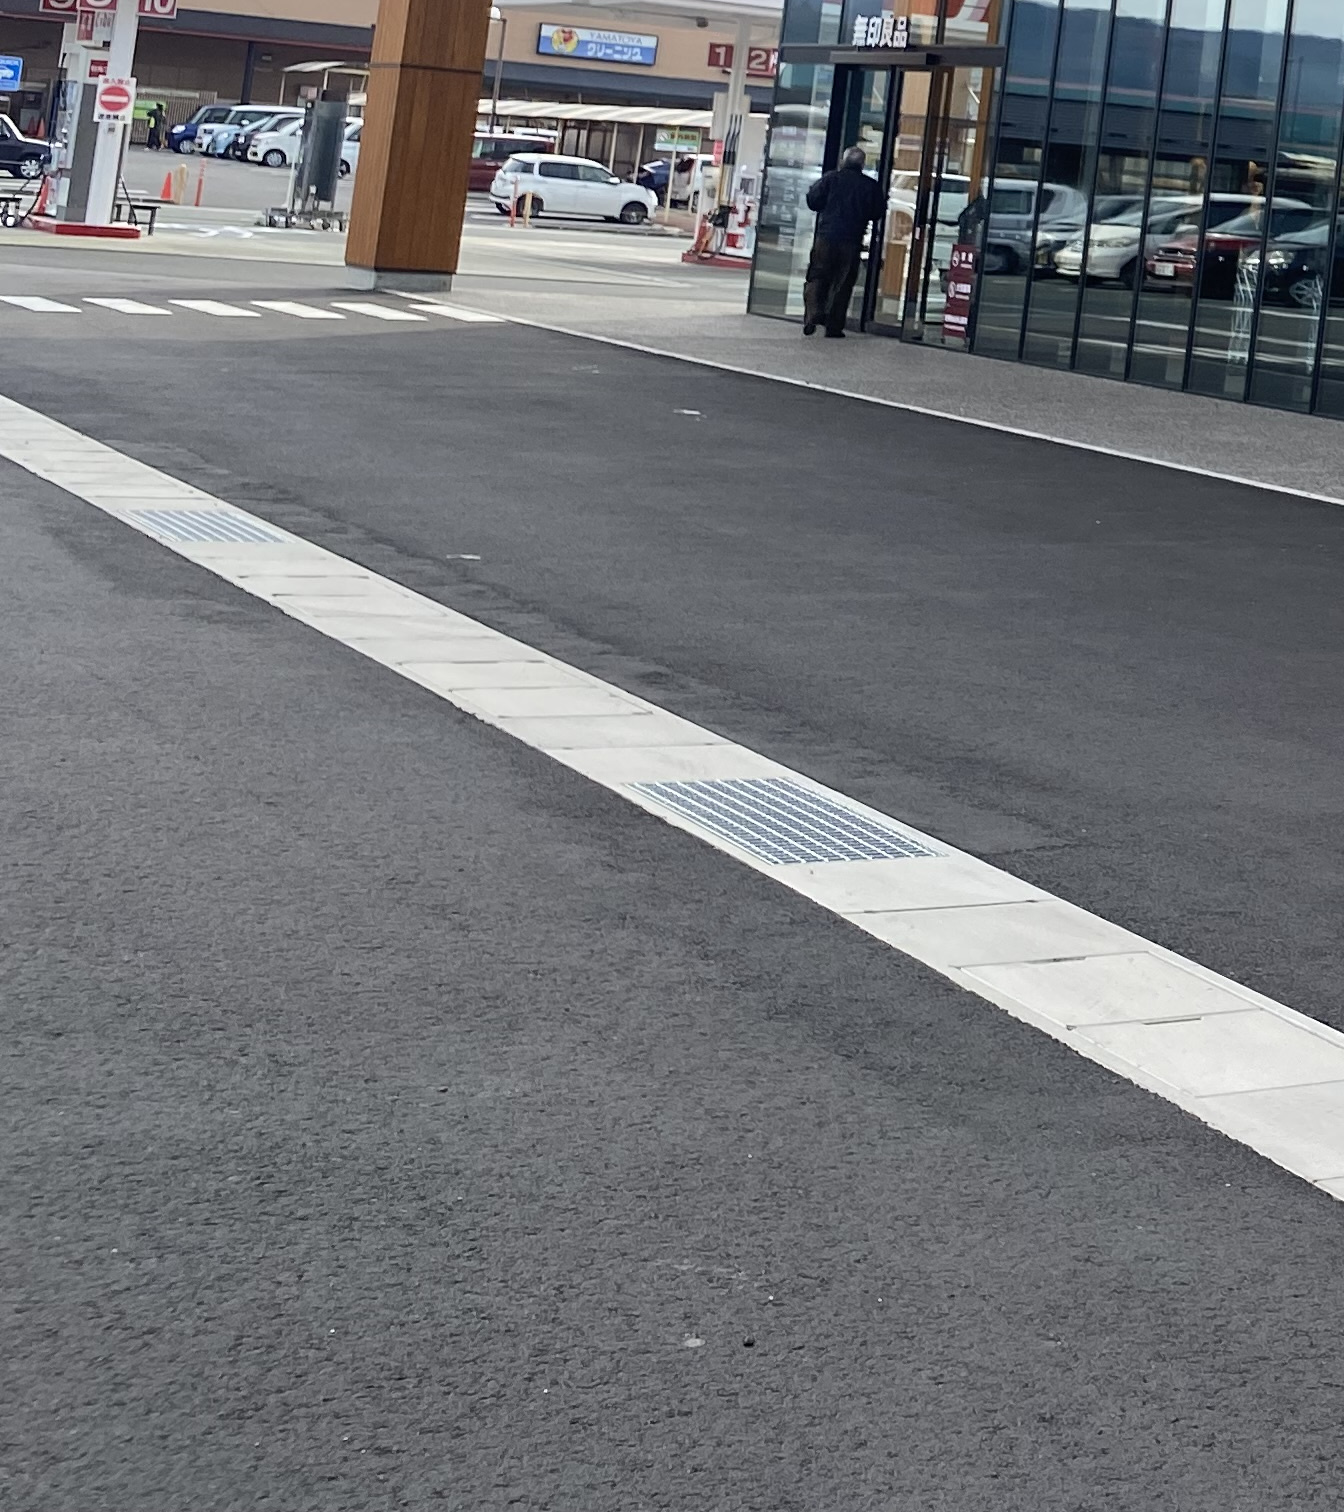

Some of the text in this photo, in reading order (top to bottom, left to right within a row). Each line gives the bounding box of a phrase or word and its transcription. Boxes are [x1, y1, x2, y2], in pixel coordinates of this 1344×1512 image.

[590, 31, 643, 46] YAMATOYA
[852, 13, 908, 48] 無印良品
[715, 46, 726, 66] 1
[749, 49, 767, 70] 2
